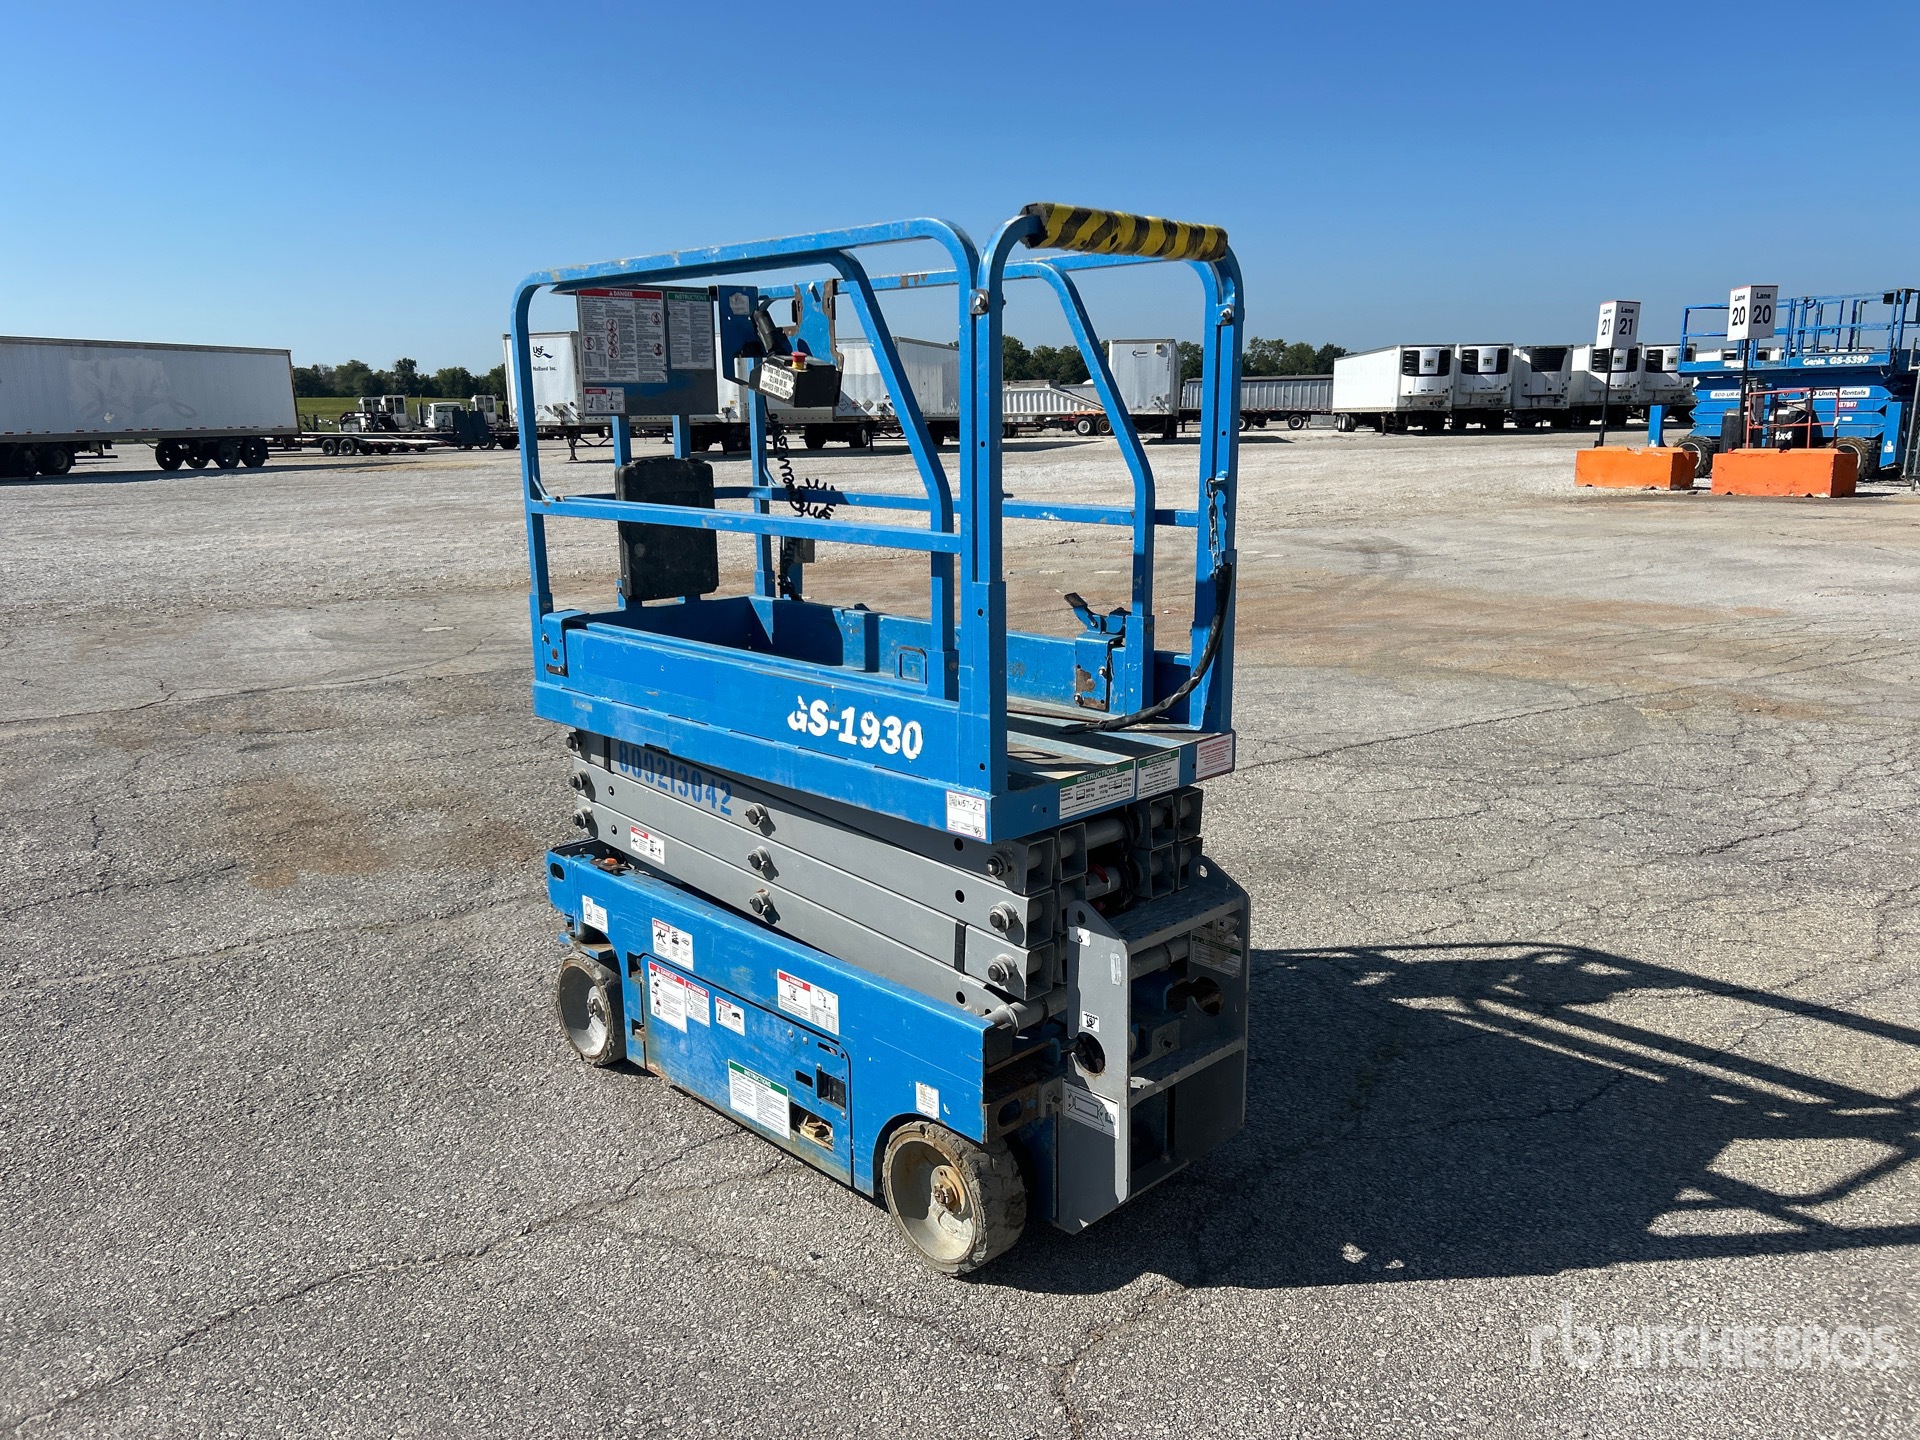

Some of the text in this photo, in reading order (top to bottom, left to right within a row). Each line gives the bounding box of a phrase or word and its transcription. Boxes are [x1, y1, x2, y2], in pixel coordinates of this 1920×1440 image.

[1732, 306, 1746, 326] 20
[1753, 304, 1772, 324] 20
[1601, 318, 1610, 336] 21
[1619, 318, 1634, 335] 21
[1802, 355, 1870, 366] Genie GS-5390
[787, 696, 924, 760] GS-1930
[1147, 753, 1171, 764] INSTRUCTIONS
[1077, 767, 1118, 783] INSTRUCTIONS
[660, 968, 677, 982] DANGER
[789, 977, 804, 988] DANGER
[692, 984, 707, 996] DANGER
[744, 1069, 772, 1088] INSTRUCTIONS
